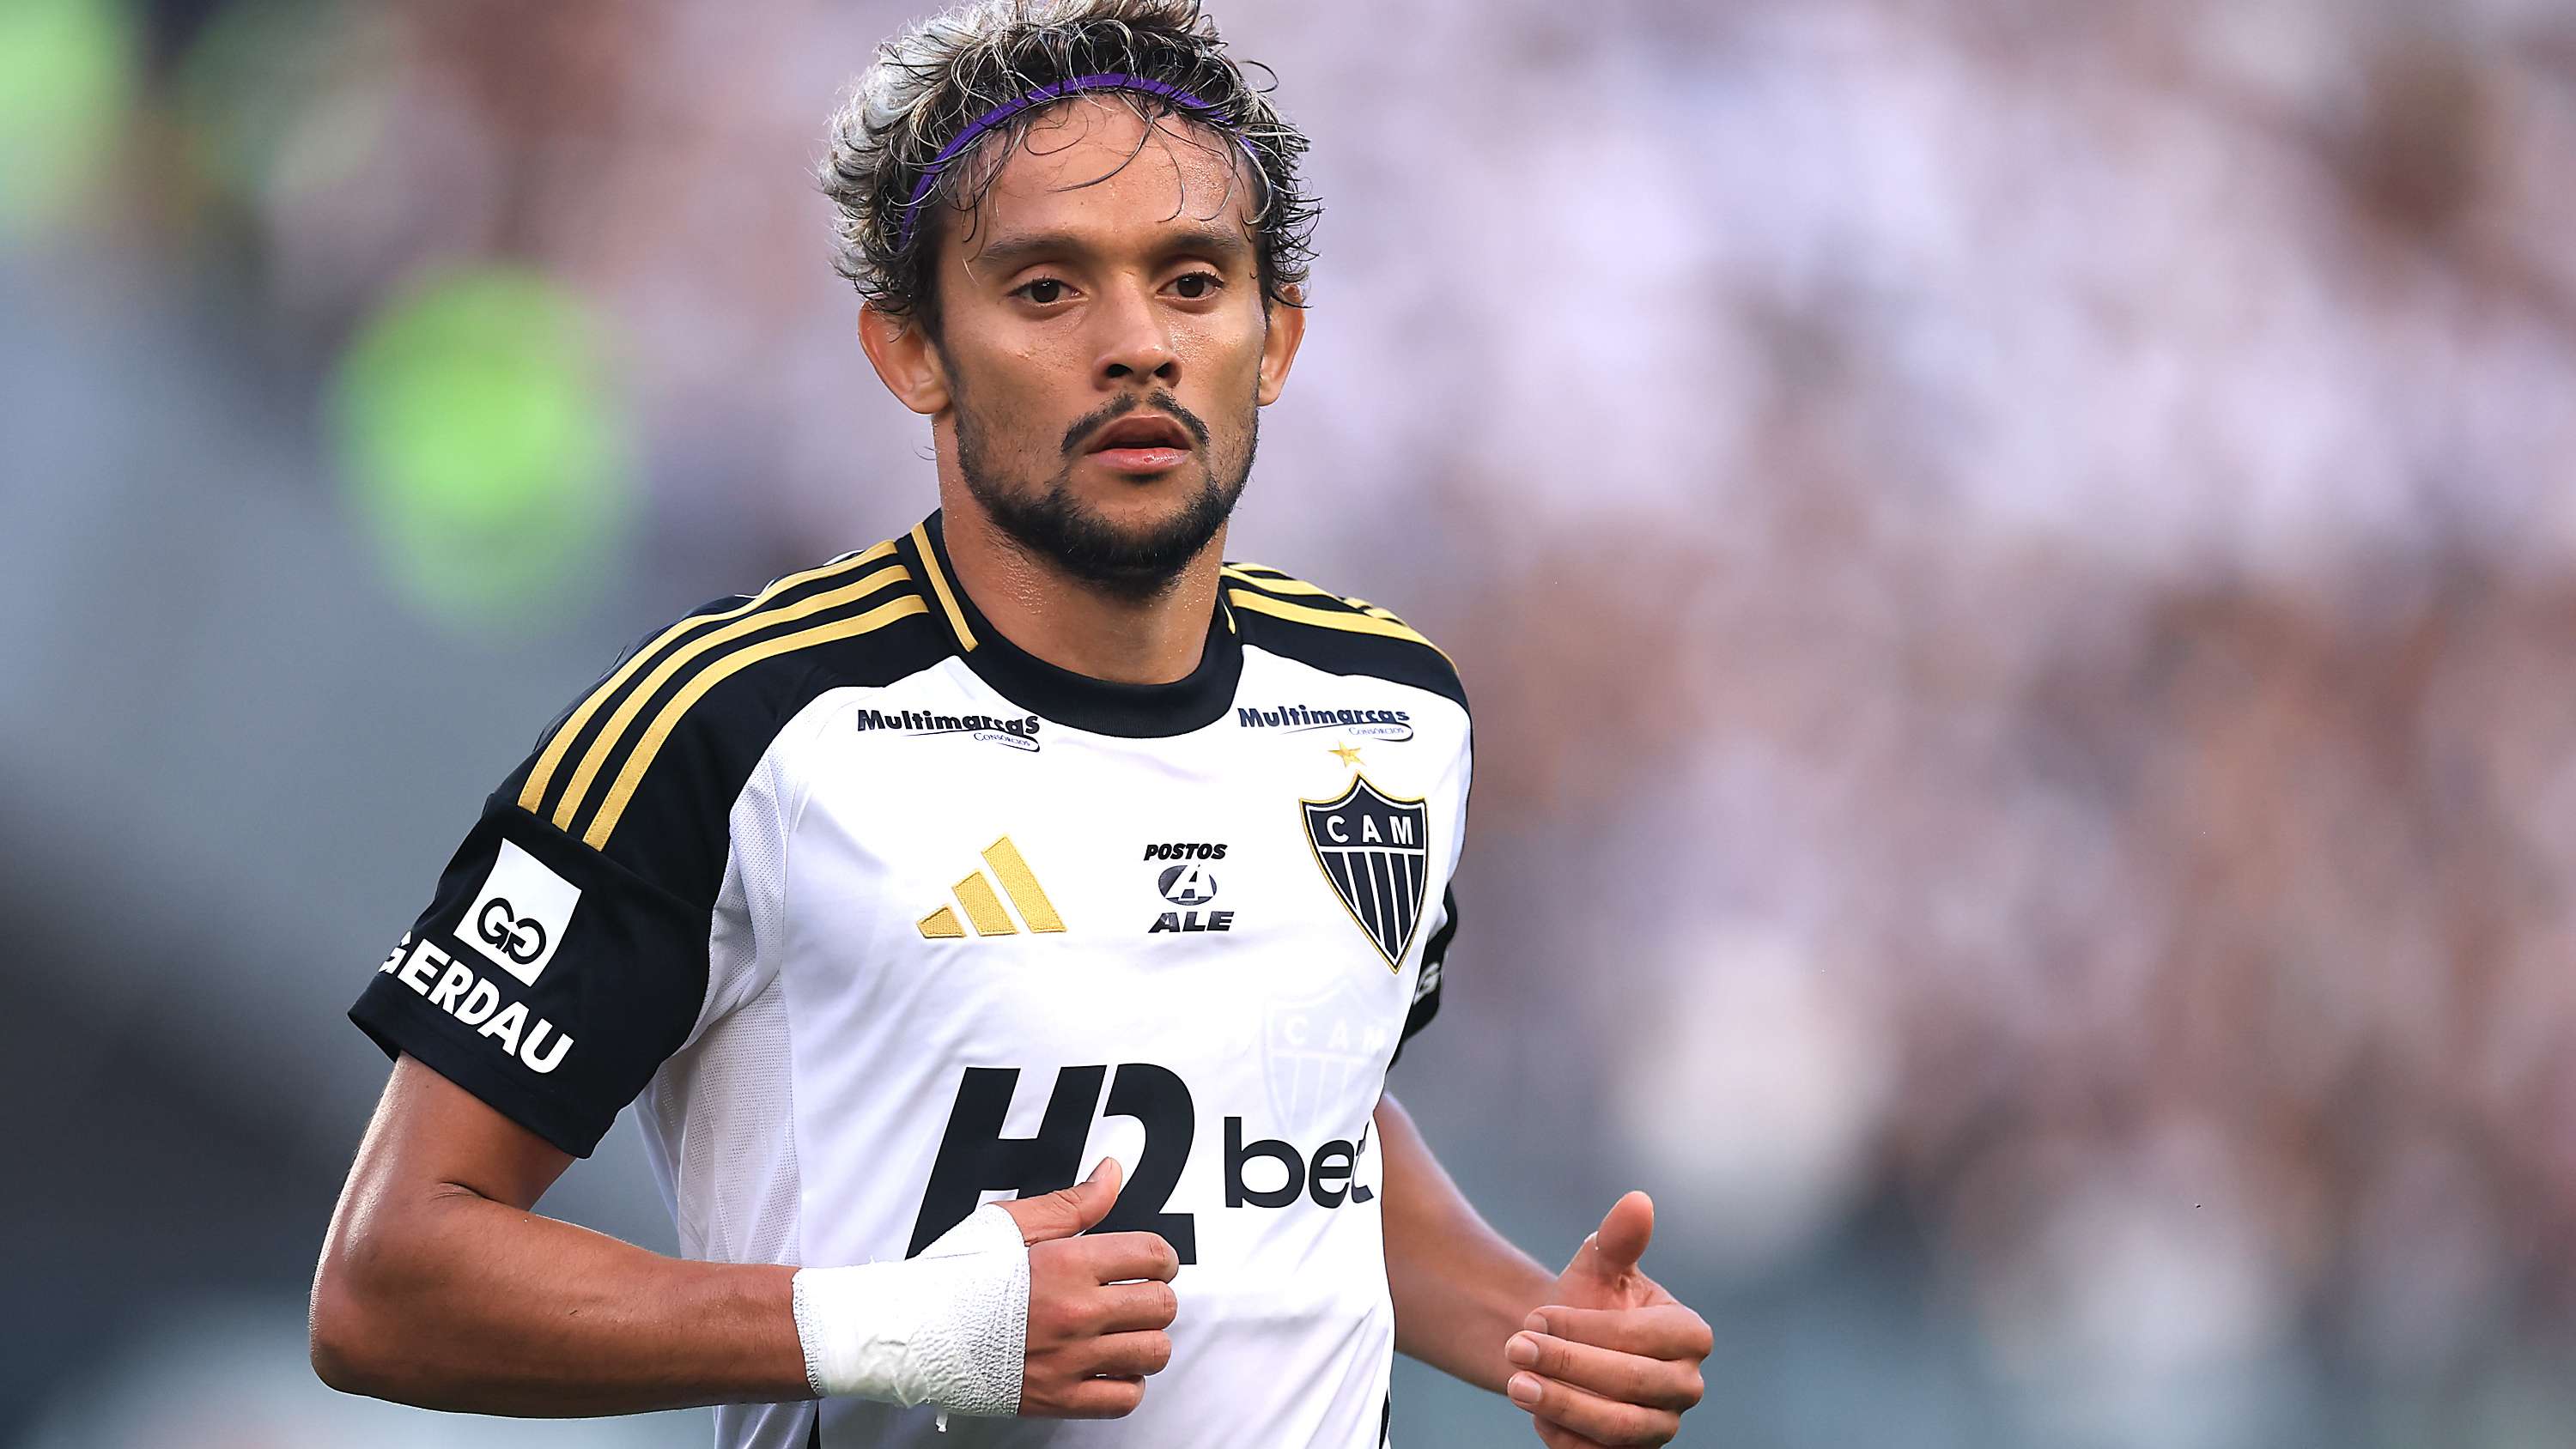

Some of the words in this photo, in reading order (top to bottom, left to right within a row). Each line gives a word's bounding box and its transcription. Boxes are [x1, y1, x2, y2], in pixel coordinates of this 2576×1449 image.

[858, 710, 1040, 737] Multimarcas
[1237, 704, 1410, 727] Multimarcas
[1327, 814, 1413, 845] CAM
[1143, 842, 1228, 861] POSTOS
[1147, 911, 1235, 933] ALE
[904, 1063, 1197, 1265] H2
